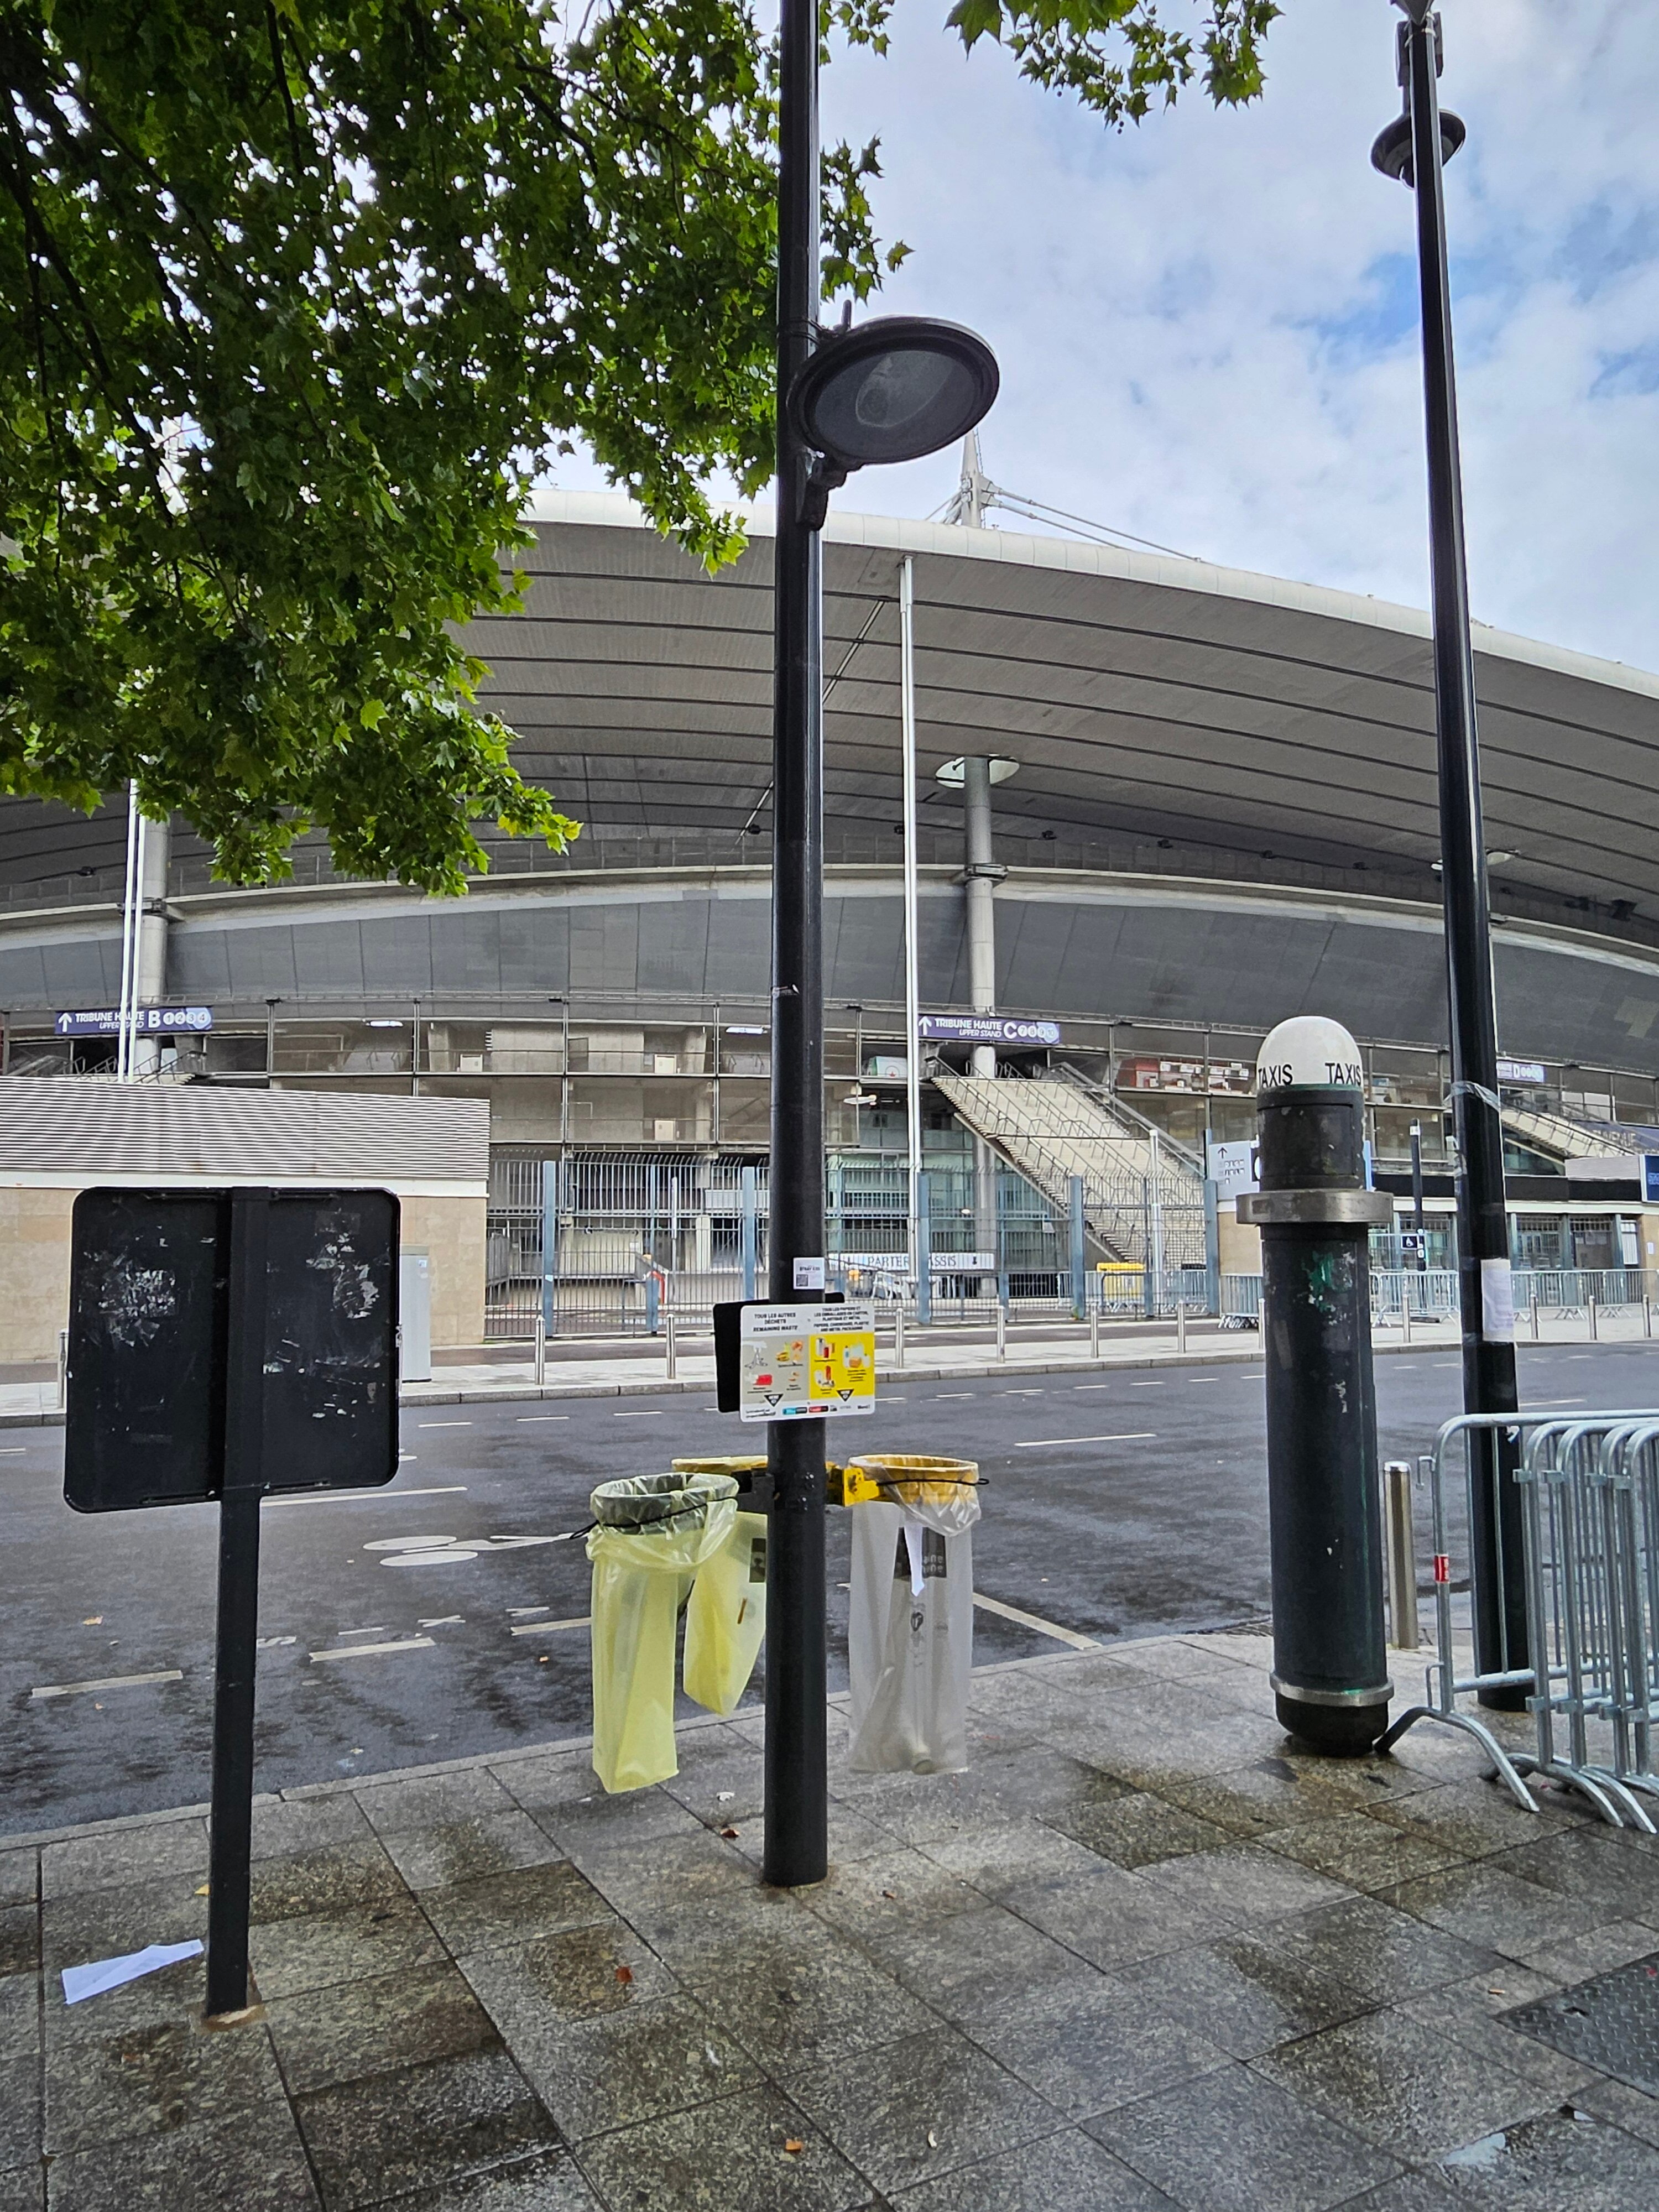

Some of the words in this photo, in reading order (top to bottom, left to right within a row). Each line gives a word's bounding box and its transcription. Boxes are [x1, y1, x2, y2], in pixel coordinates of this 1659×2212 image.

[75, 1012, 113, 1022] TRIBUNE
[114, 1011, 144, 1021] HUTE
[148, 1010, 161, 1028] B
[935, 1018, 972, 1029] TRIBUNE
[973, 1020, 1001, 1030] HAUTE
[1003, 1021, 1017, 1039] C
[1259, 1064, 1293, 1088] TAXIS
[1324, 1062, 1361, 1086] TAXIS
[868, 1256, 908, 1267] PARTER
[931, 1256, 956, 1266] SSIS
